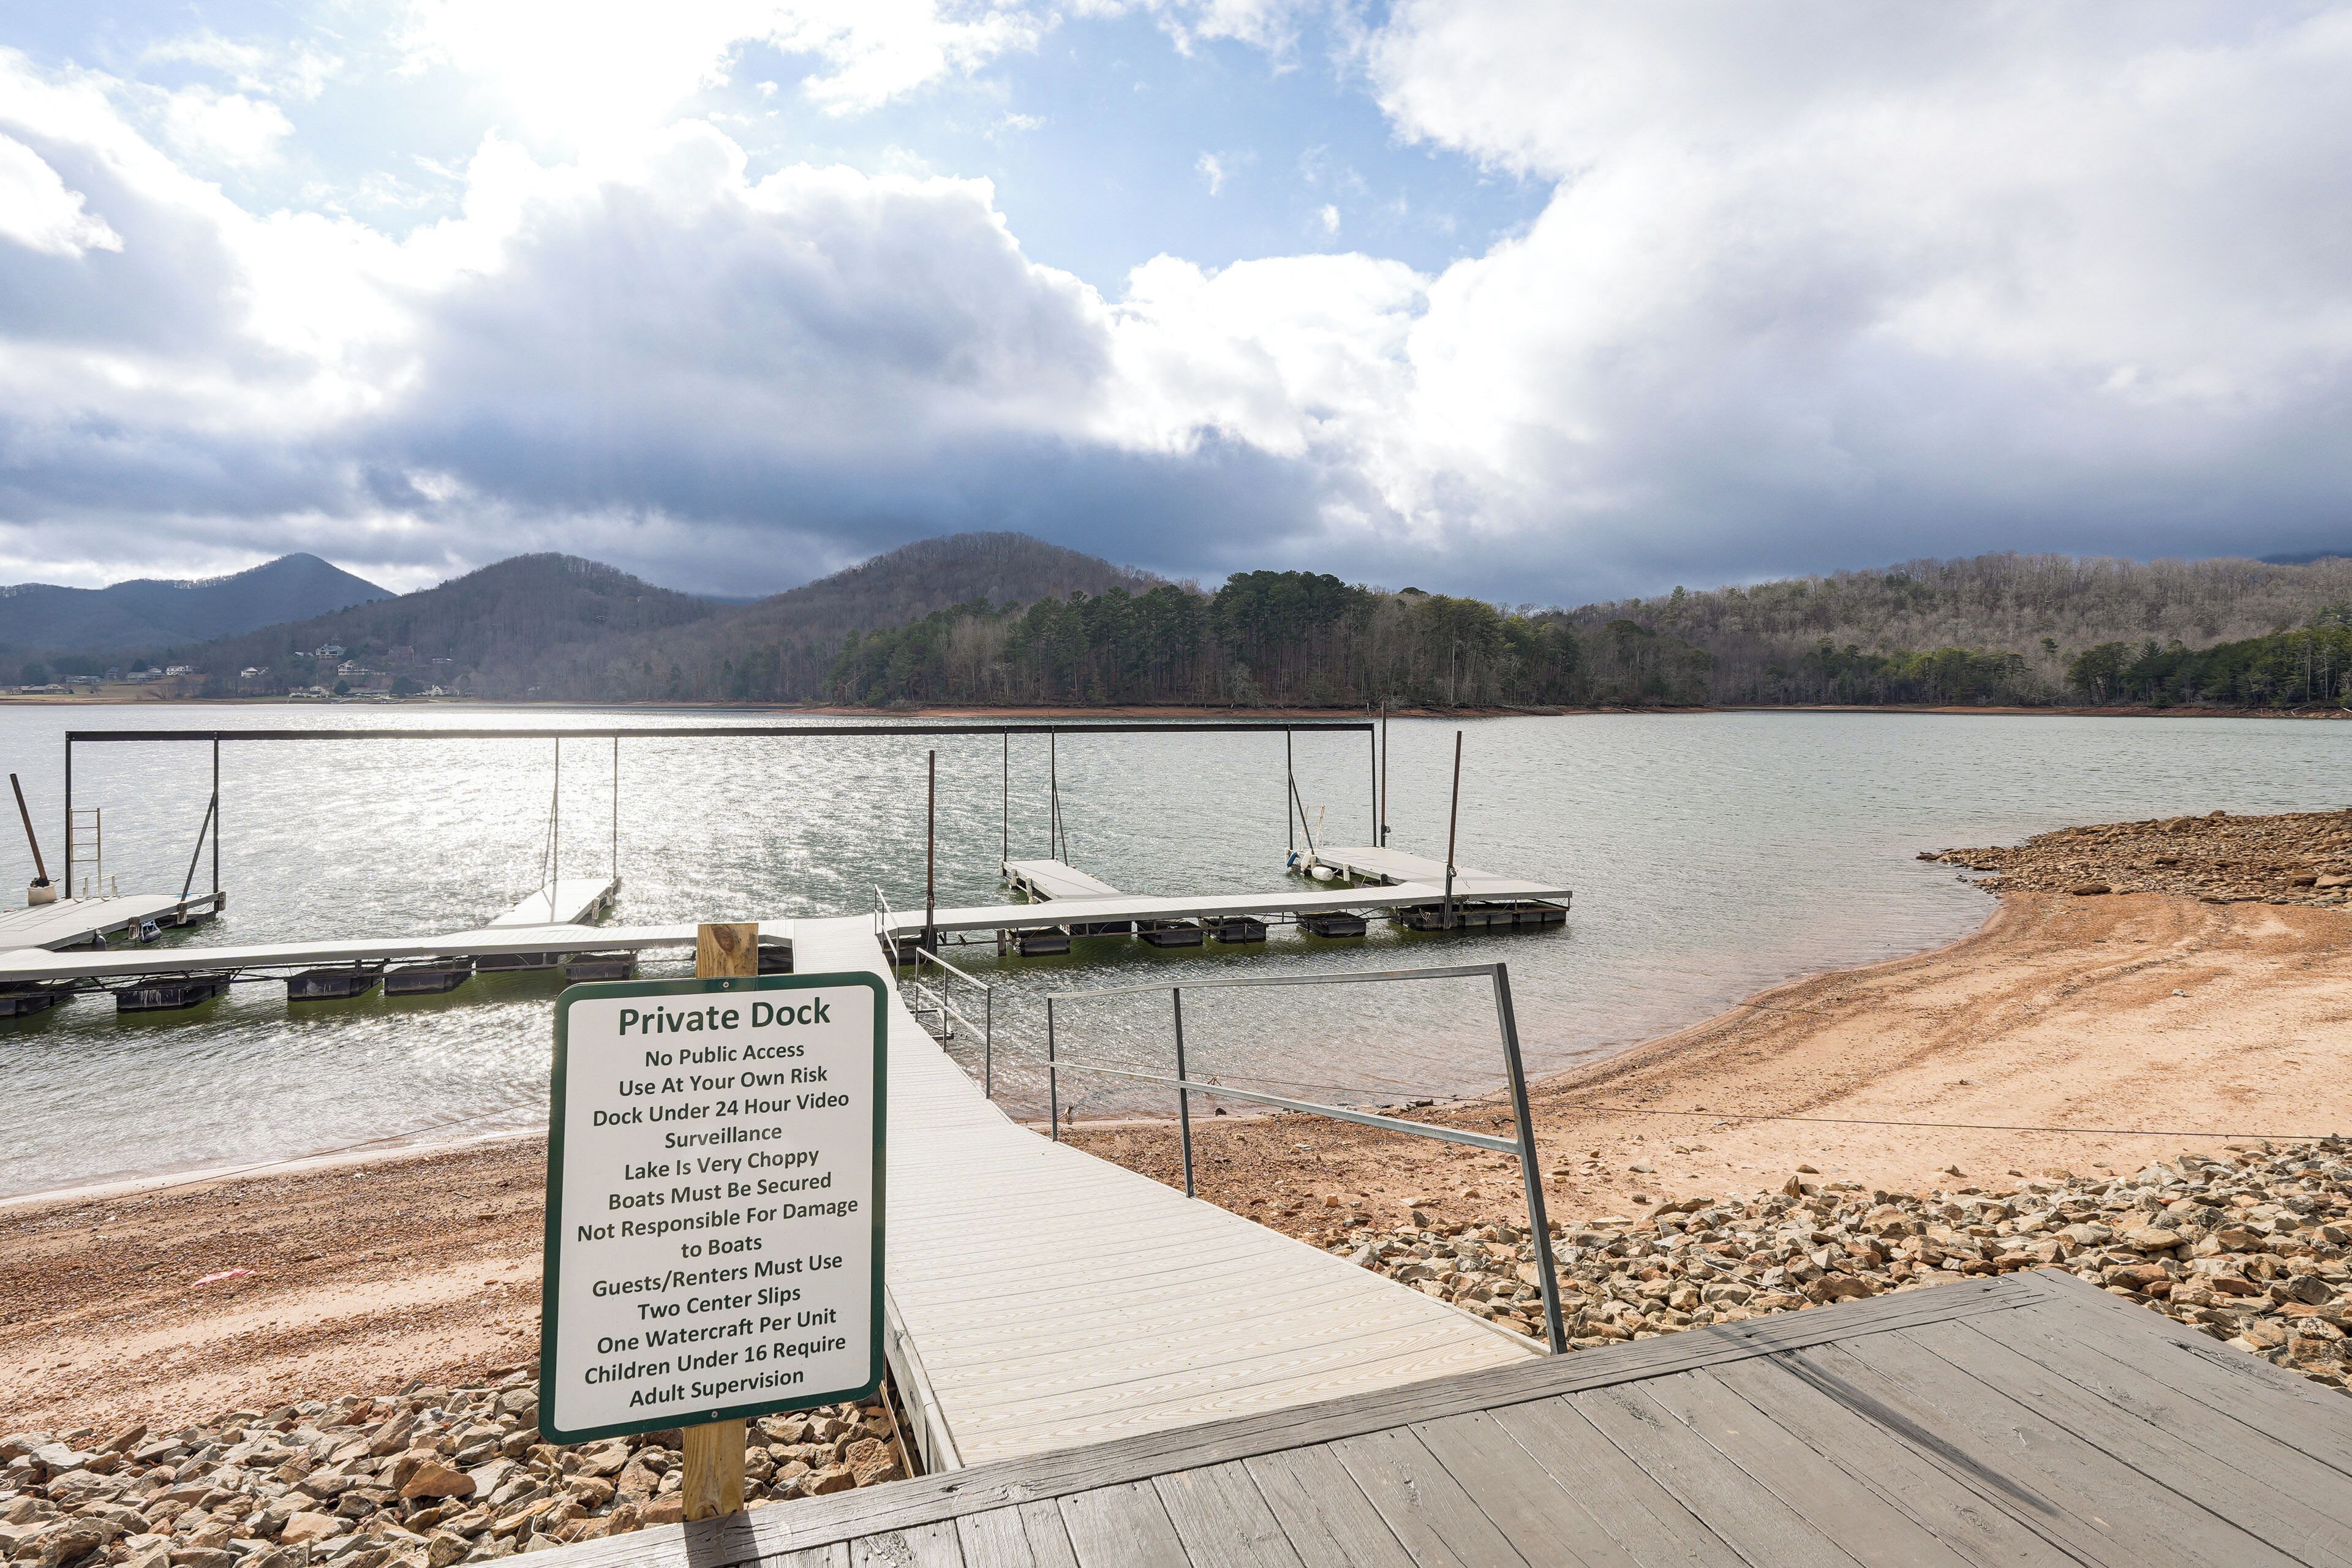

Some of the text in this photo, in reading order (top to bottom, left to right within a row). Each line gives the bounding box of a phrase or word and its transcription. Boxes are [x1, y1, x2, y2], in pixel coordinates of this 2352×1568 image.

[619, 997, 831, 1036] Private Dock
[646, 1044, 804, 1067] No Public Access
[619, 1065, 827, 1096] Use At Your Own Risk
[594, 1091, 849, 1127] Dock Under 24 Hour Video
[665, 1126, 782, 1149] Surveillance
[625, 1150, 820, 1180] Lake Is Very Choppy
[609, 1171, 831, 1210] Boats Must Be Secured
[578, 1200, 858, 1242] Not Responsible For Damage
[680, 1236, 762, 1259] to Boats
[592, 1254, 843, 1297] Guests/Renters Must Use
[637, 1286, 801, 1321] Two Center Slips
[597, 1308, 837, 1354] One Watercraft Per Unit
[584, 1335, 846, 1385] Children Under 16 Require
[628, 1370, 804, 1408] Adult Supervision
